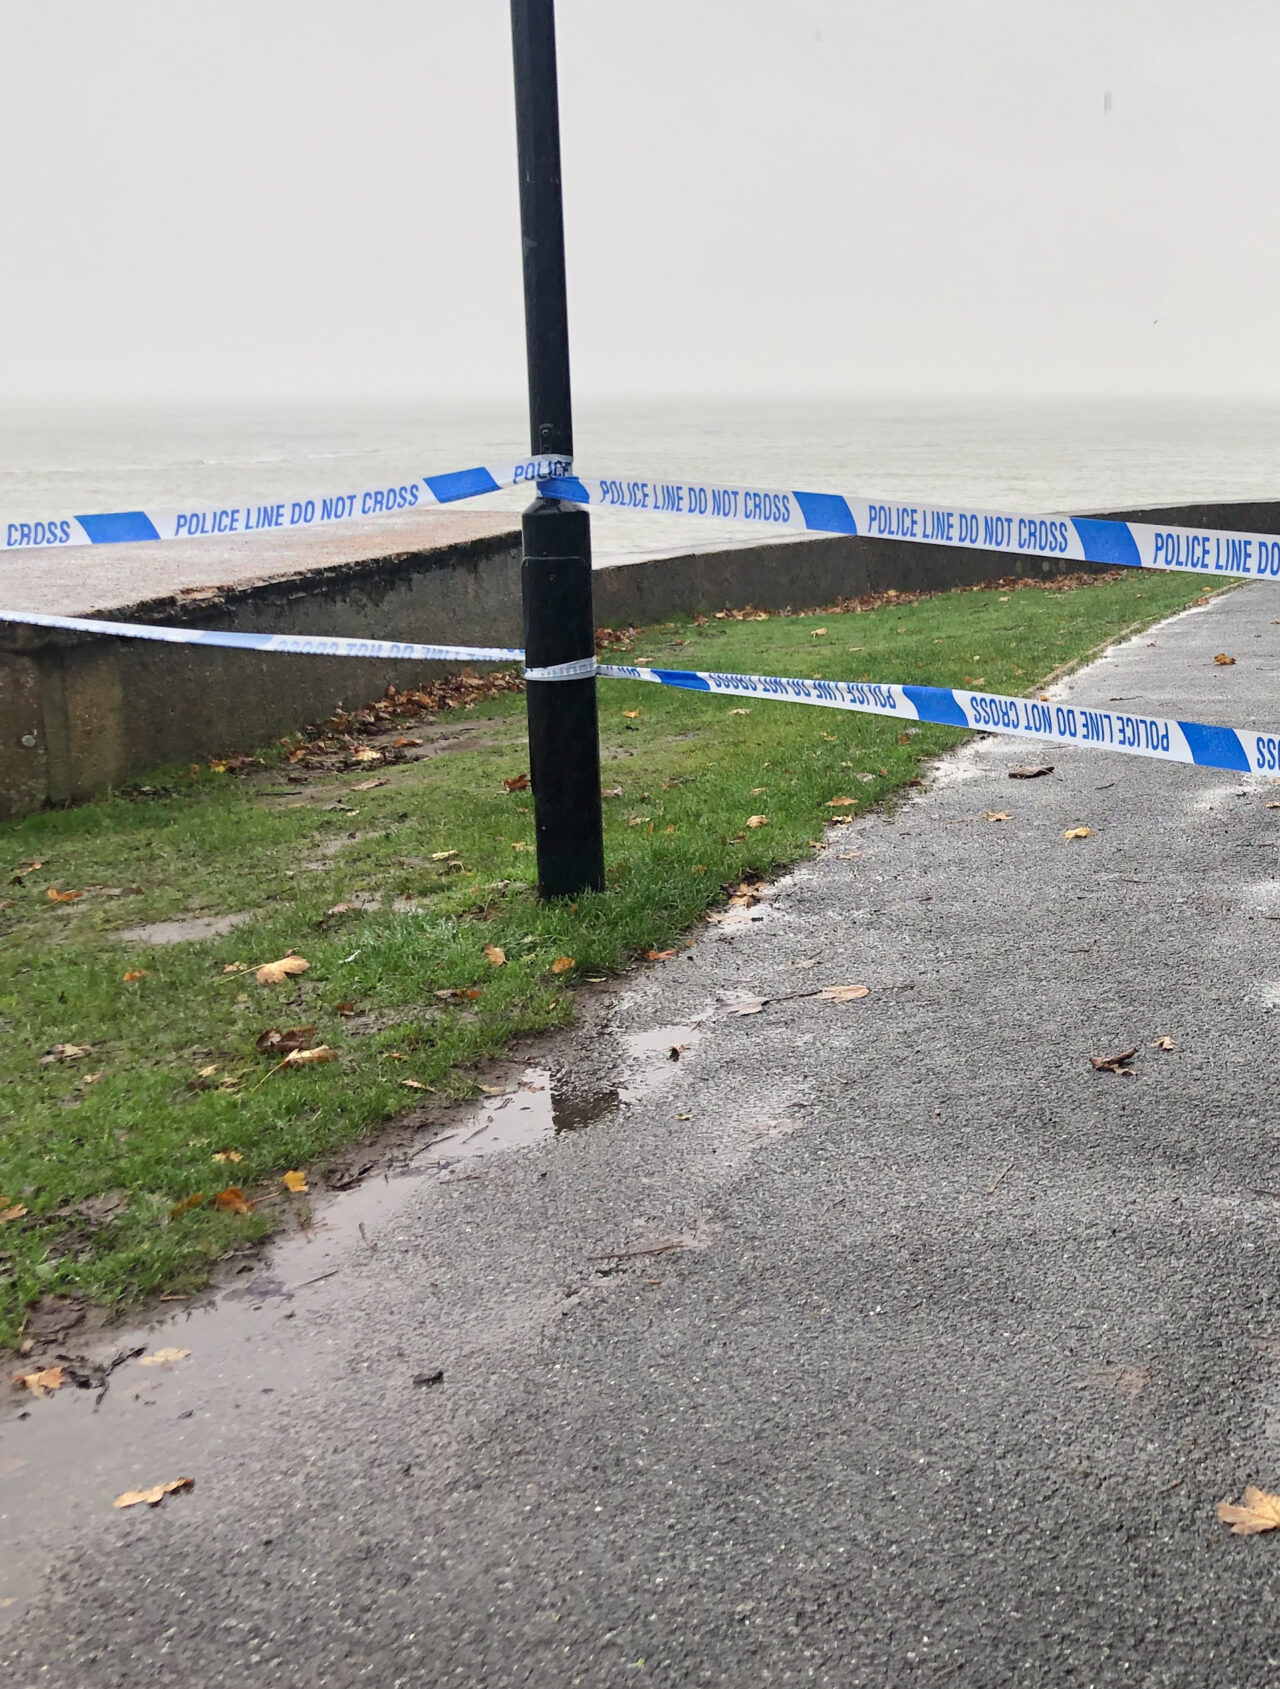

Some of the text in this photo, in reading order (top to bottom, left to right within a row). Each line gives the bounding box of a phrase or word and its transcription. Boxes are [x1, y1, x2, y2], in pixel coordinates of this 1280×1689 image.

[174, 484, 420, 537] POLICE LINE DO NOT CROSS
[600, 480, 791, 523] POLICE LINE DO NOT CROSS
[7, 520, 71, 546] CROSS
[868, 504, 1069, 553] POLICE LINE DO NOT CROSS
[1153, 532, 1211, 569] POLICE
[1214, 538, 1252, 573] LINE
[1257, 541, 1280, 576] DO
[846, 682, 896, 709] POLICE
[970, 696, 1170, 752] POLICE LINE DO NOT CROSS
